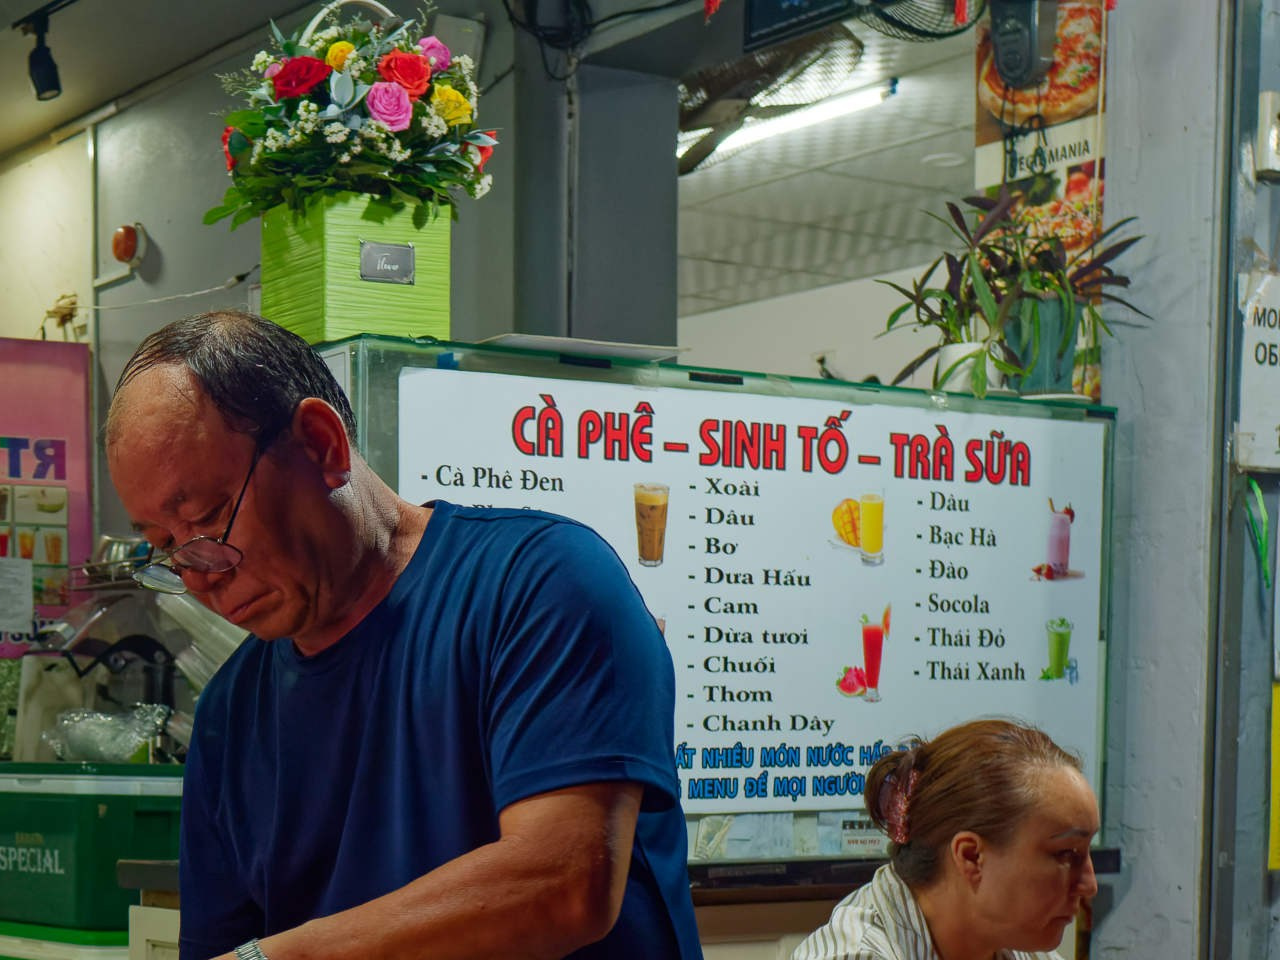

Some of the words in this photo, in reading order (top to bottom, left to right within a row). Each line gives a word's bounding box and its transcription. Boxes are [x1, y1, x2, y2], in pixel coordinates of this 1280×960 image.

[511, 393, 564, 458] CÀ
[577, 401, 656, 463] PHÊ
[699, 419, 787, 471] SINH
[797, 410, 852, 475] TỐ
[890, 424, 955, 482] TRÀ
[964, 429, 1031, 487] SỮA
[435, 464, 465, 487] Cà
[472, 466, 513, 490] Phê
[520, 469, 565, 492] Đen
[705, 477, 760, 497] Xoài
[705, 507, 755, 526] Dâu
[705, 536, 738, 555] Bơ
[929, 525, 964, 549] Bạc
[970, 527, 997, 547] Hà
[704, 566, 754, 585] Dưa
[762, 569, 811, 587] Hấu
[928, 559, 968, 580] Đào
[704, 596, 759, 614] Cam
[928, 592, 990, 614] Socola
[704, 626, 753, 644] Dừa
[762, 628, 809, 645] tươi
[927, 627, 971, 648] Thái
[978, 628, 1005, 649] Đỏ
[703, 655, 776, 673] Chuối
[926, 660, 970, 681] Thái
[977, 661, 1026, 681] Xanh
[703, 714, 781, 732] Chanh
[790, 714, 835, 737] Dây
[675, 742, 696, 769] ẤT
[760, 742, 800, 768] MÓN
[688, 778, 739, 799] MENU
[773, 776, 806, 802] MỌI
